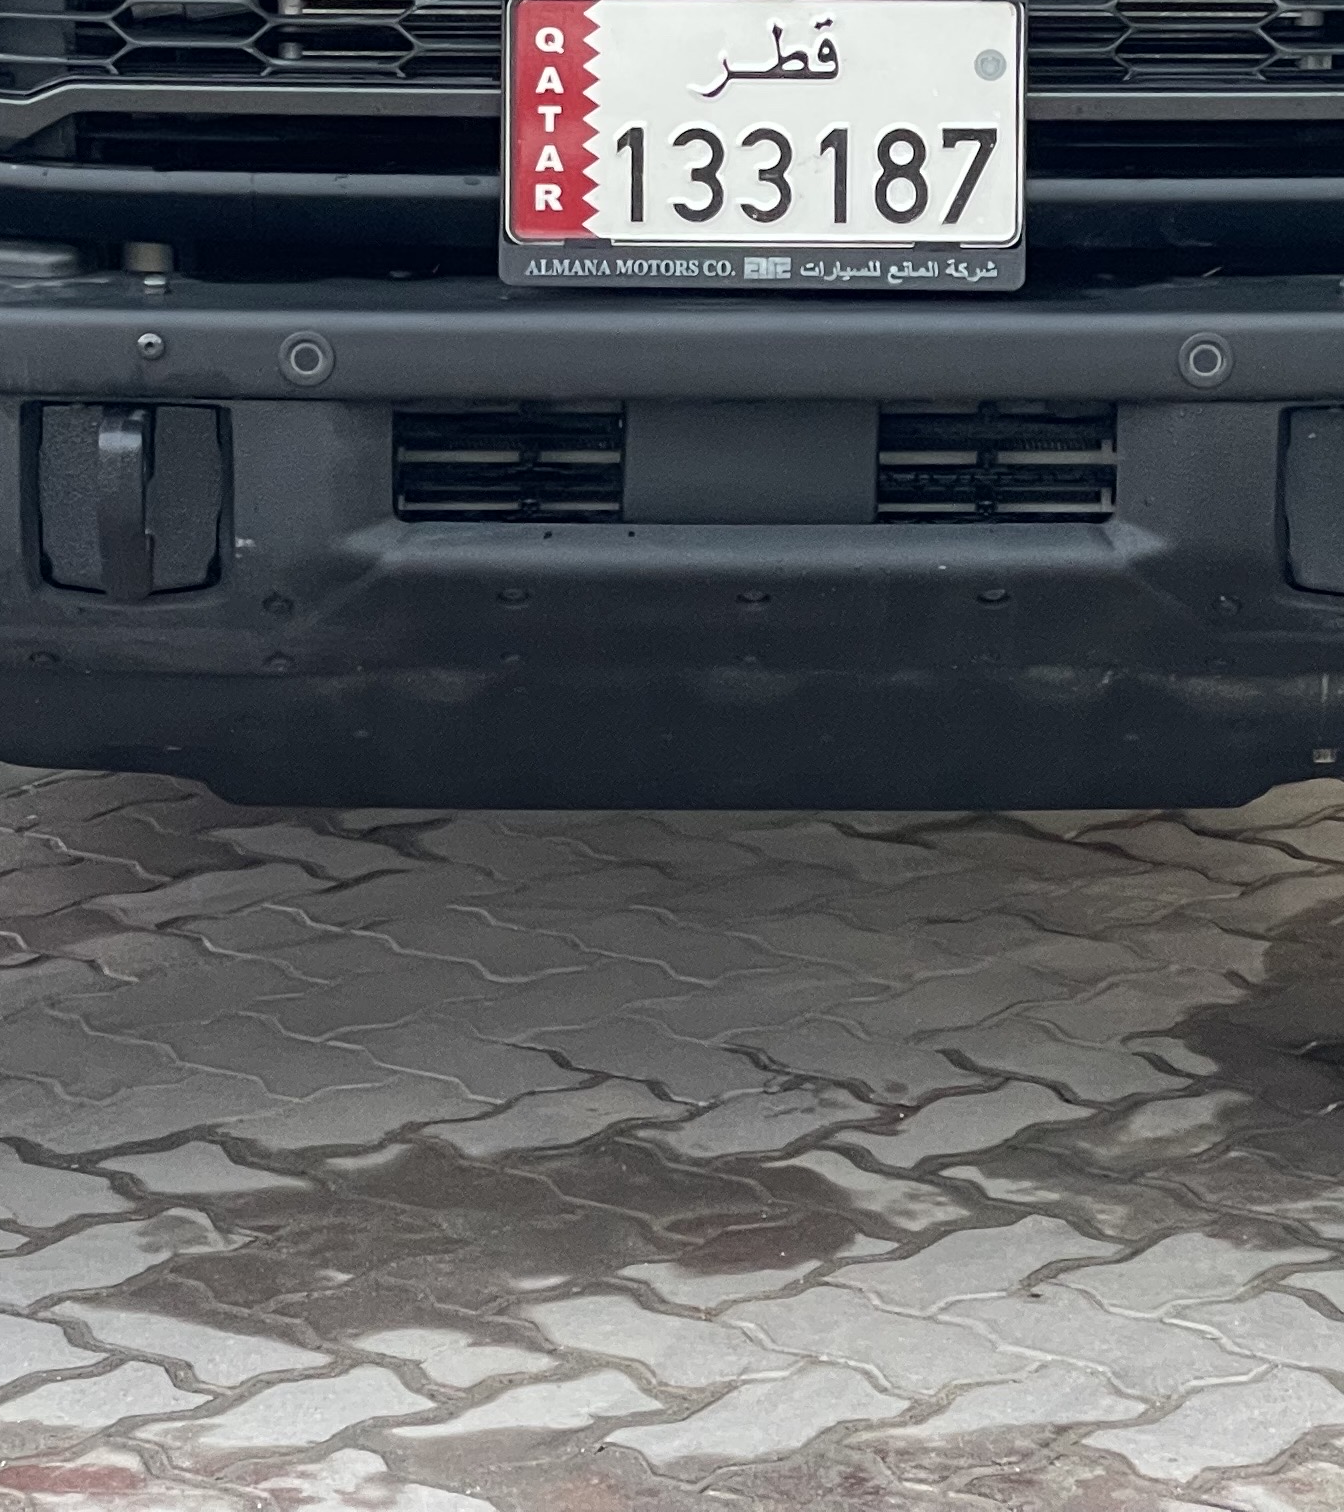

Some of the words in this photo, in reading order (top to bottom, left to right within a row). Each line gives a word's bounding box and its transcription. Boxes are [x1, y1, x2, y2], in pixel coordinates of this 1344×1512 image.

[687, 18, 841, 101] قطر
[534, 27, 564, 211] QATAR
[615, 127, 999, 226] 133187
[525, 258, 611, 276] ALMANA
[615, 259, 699, 276] MOTORS
[702, 259, 736, 277] CO.
[800, 260, 881, 281] للسيارات
[887, 260, 939, 284] المانع
[945, 259, 998, 282] شركة
